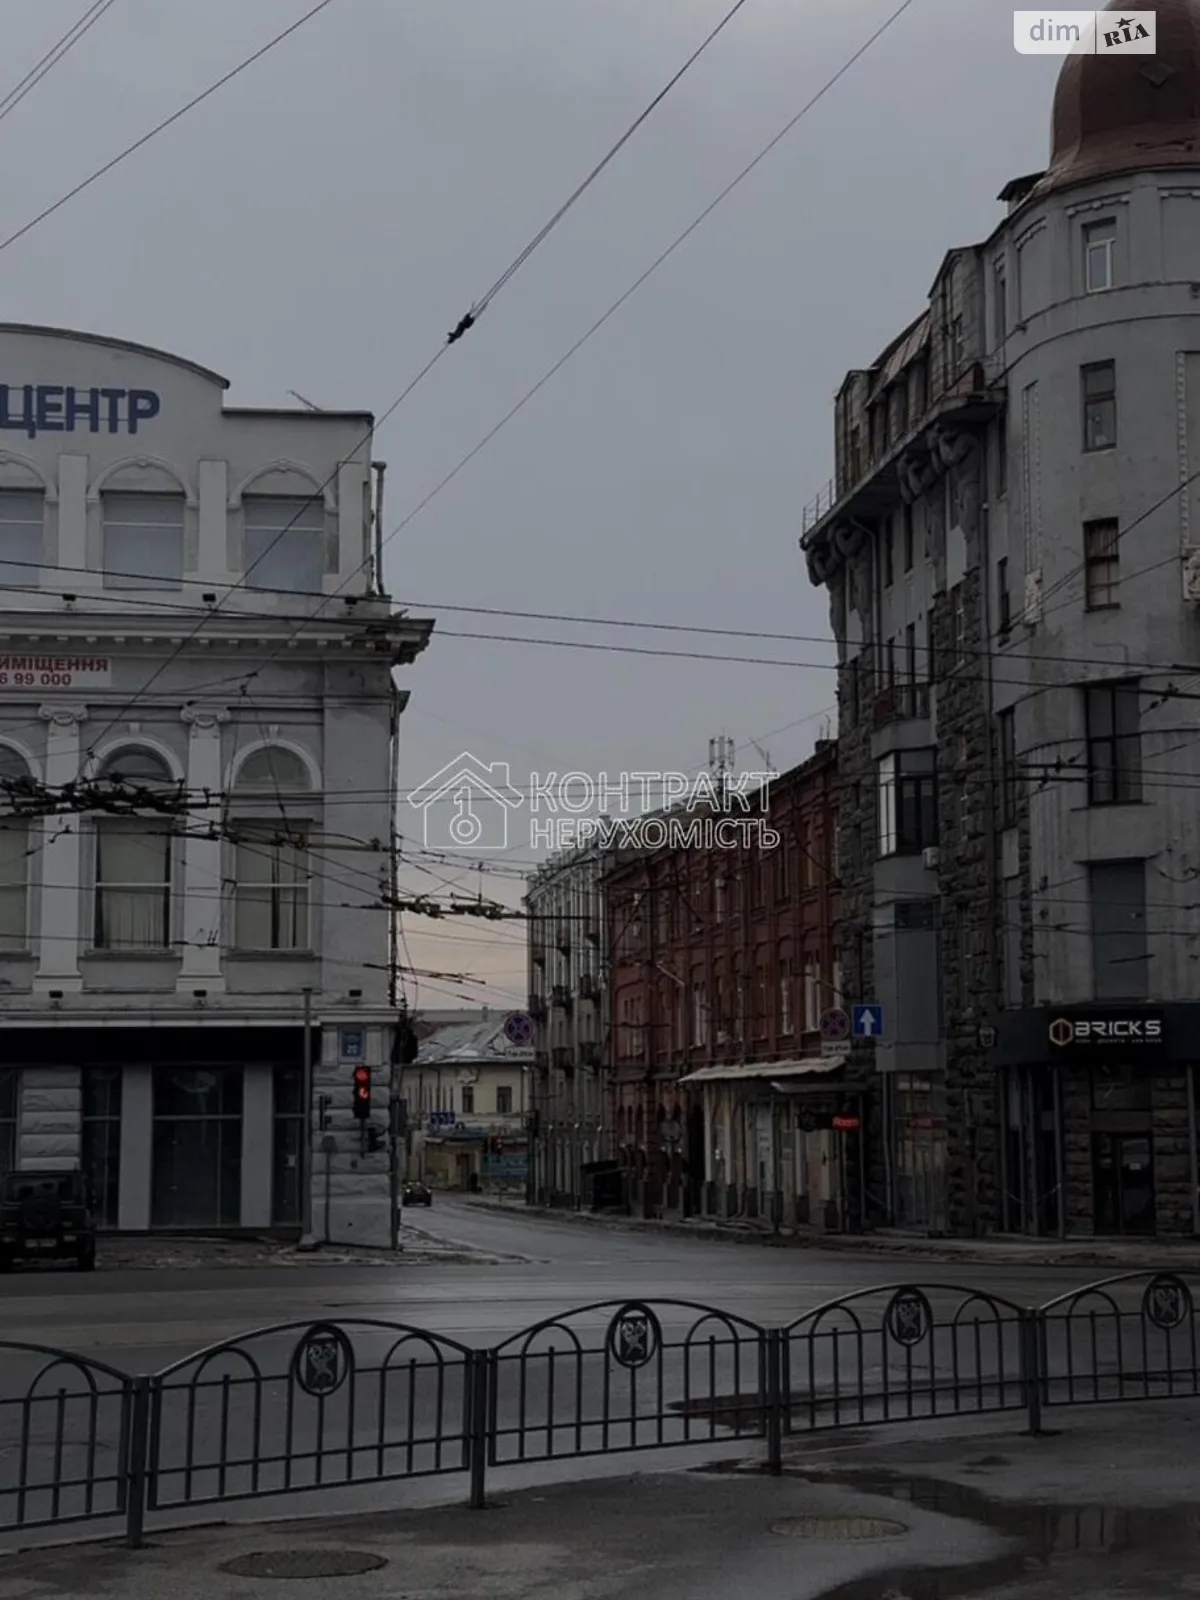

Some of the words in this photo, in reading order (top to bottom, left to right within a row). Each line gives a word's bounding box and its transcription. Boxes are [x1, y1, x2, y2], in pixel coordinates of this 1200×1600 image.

[0, 384, 160, 438] ЦЕНТР
[14, 673, 35, 685] 99
[41, 673, 72, 686] 000
[1074, 1019, 1162, 1036] BRICKS
